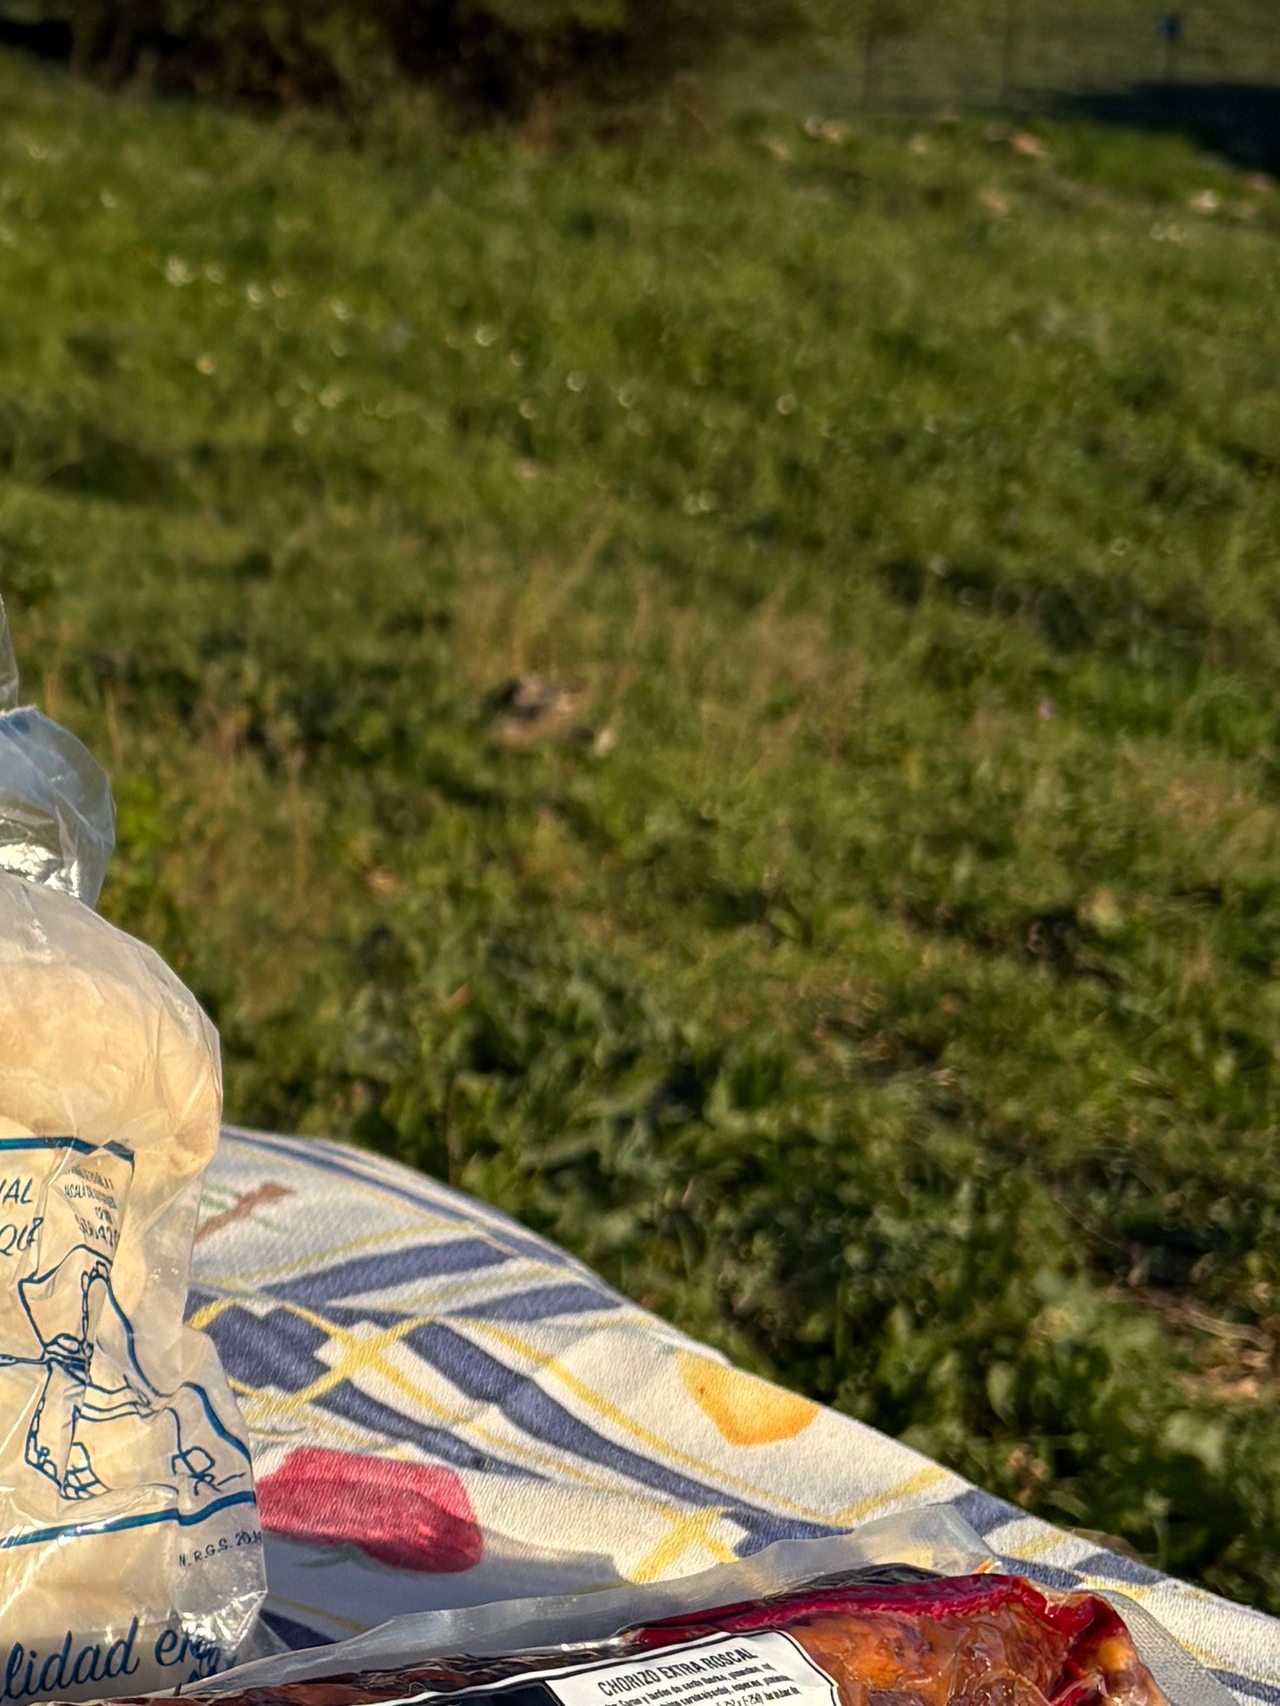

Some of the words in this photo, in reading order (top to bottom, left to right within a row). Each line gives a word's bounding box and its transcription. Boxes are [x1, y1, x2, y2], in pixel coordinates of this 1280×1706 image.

[597, 1669, 661, 1697] CHORIZO
[656, 1660, 703, 1682] EXTRA
[701, 1646, 759, 1674] ROSCAL
